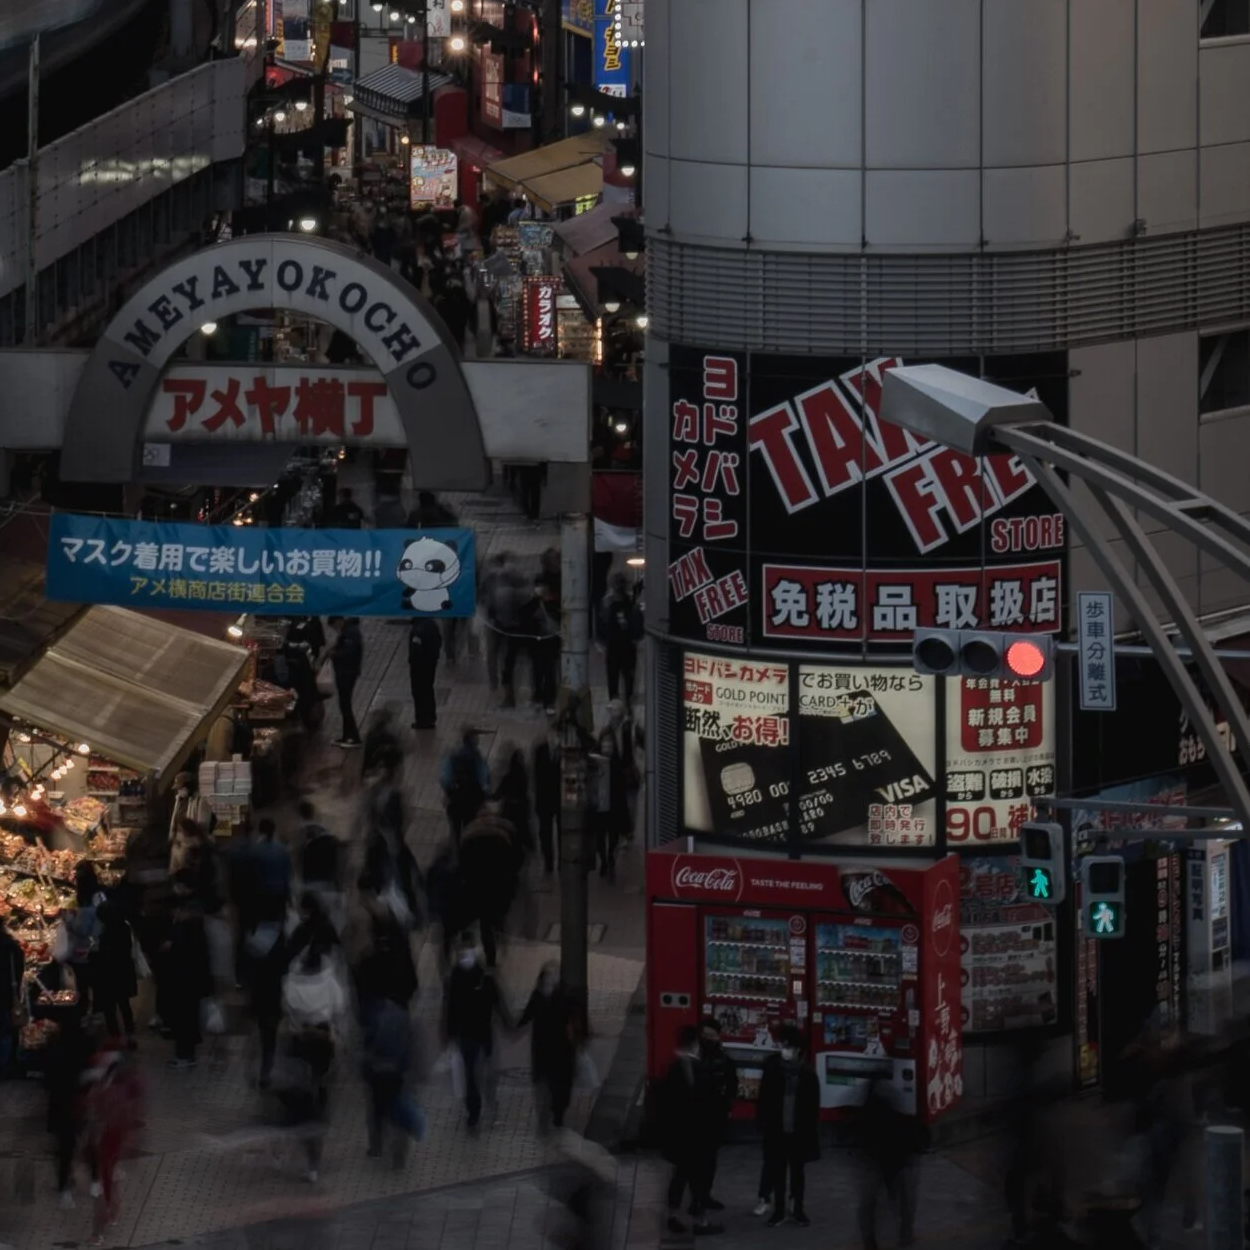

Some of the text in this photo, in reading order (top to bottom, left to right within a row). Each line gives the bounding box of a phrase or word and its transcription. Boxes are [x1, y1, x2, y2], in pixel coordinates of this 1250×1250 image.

[107, 257, 437, 391] AMEYAYOKOCHO
[538, 286, 551, 340] カラオケ
[161, 376, 388, 437] アメヤ横丁
[703, 355, 740, 541] ヨドバシ
[672, 398, 700, 538] カメラ
[882, 390, 1052, 555] FRE
[991, 512, 1064, 554] STORE
[130, 576, 305, 604] アメ横商店街連合会
[668, 546, 714, 603] TAX
[693, 569, 749, 625] FREE
[769, 576, 1059, 632] 免税品取扱店
[707, 623, 744, 643] STORE
[1086, 600, 1107, 702] 歩車分離式
[685, 657, 923, 691] ヨドバシカメラ でお買い物なら
[716, 687, 746, 702] GOLD
[750, 690, 787, 705] POINT
[800, 694, 836, 708] CARD
[990, 689, 1016, 703] 無料
[968, 705, 1037, 727] 新規会員
[978, 727, 1029, 748] 募集中
[727, 789, 762, 810] 4980
[807, 762, 846, 784] 2345
[852, 749, 892, 770] 6789
[874, 774, 930, 803] VISA
[947, 773, 983, 792] 盗難
[991, 770, 1021, 790] 破損
[870, 820, 925, 832] 即時発行
[946, 806, 996, 841] 90
[675, 865, 738, 891] Coca-Cola
[750, 878, 823, 891] TASTE THE FEELING
